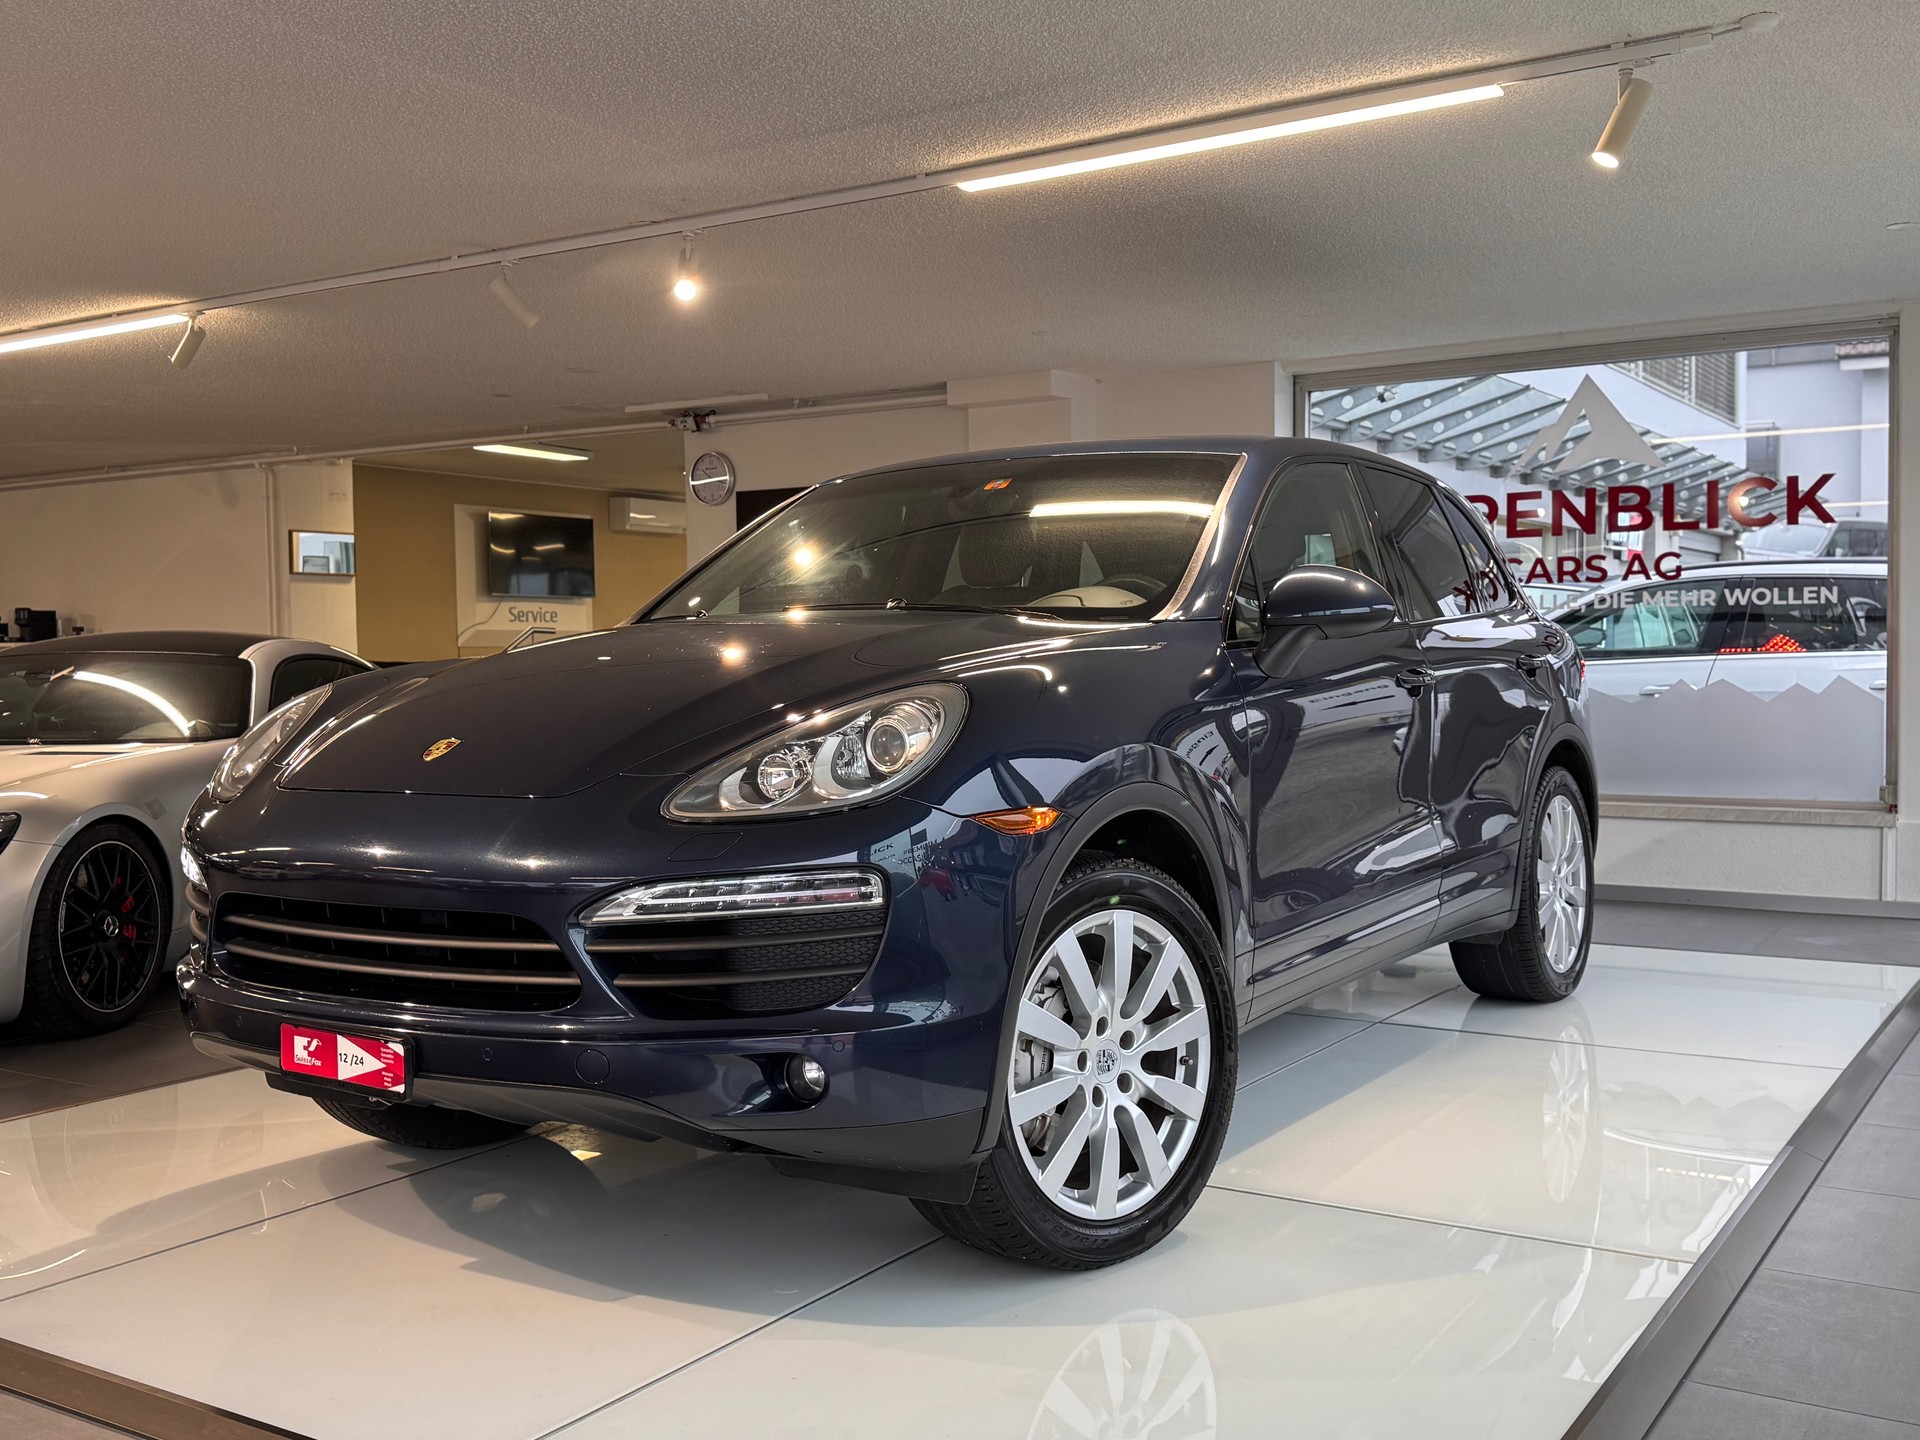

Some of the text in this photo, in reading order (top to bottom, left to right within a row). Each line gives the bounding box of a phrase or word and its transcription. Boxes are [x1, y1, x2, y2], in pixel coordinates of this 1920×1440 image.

[1621, 551, 1683, 581] AG
[1593, 591, 1635, 610] DIE
[1642, 588, 1717, 609] MEHR
[1723, 586, 1839, 606] WOLLEN
[508, 606, 558, 624] Service
